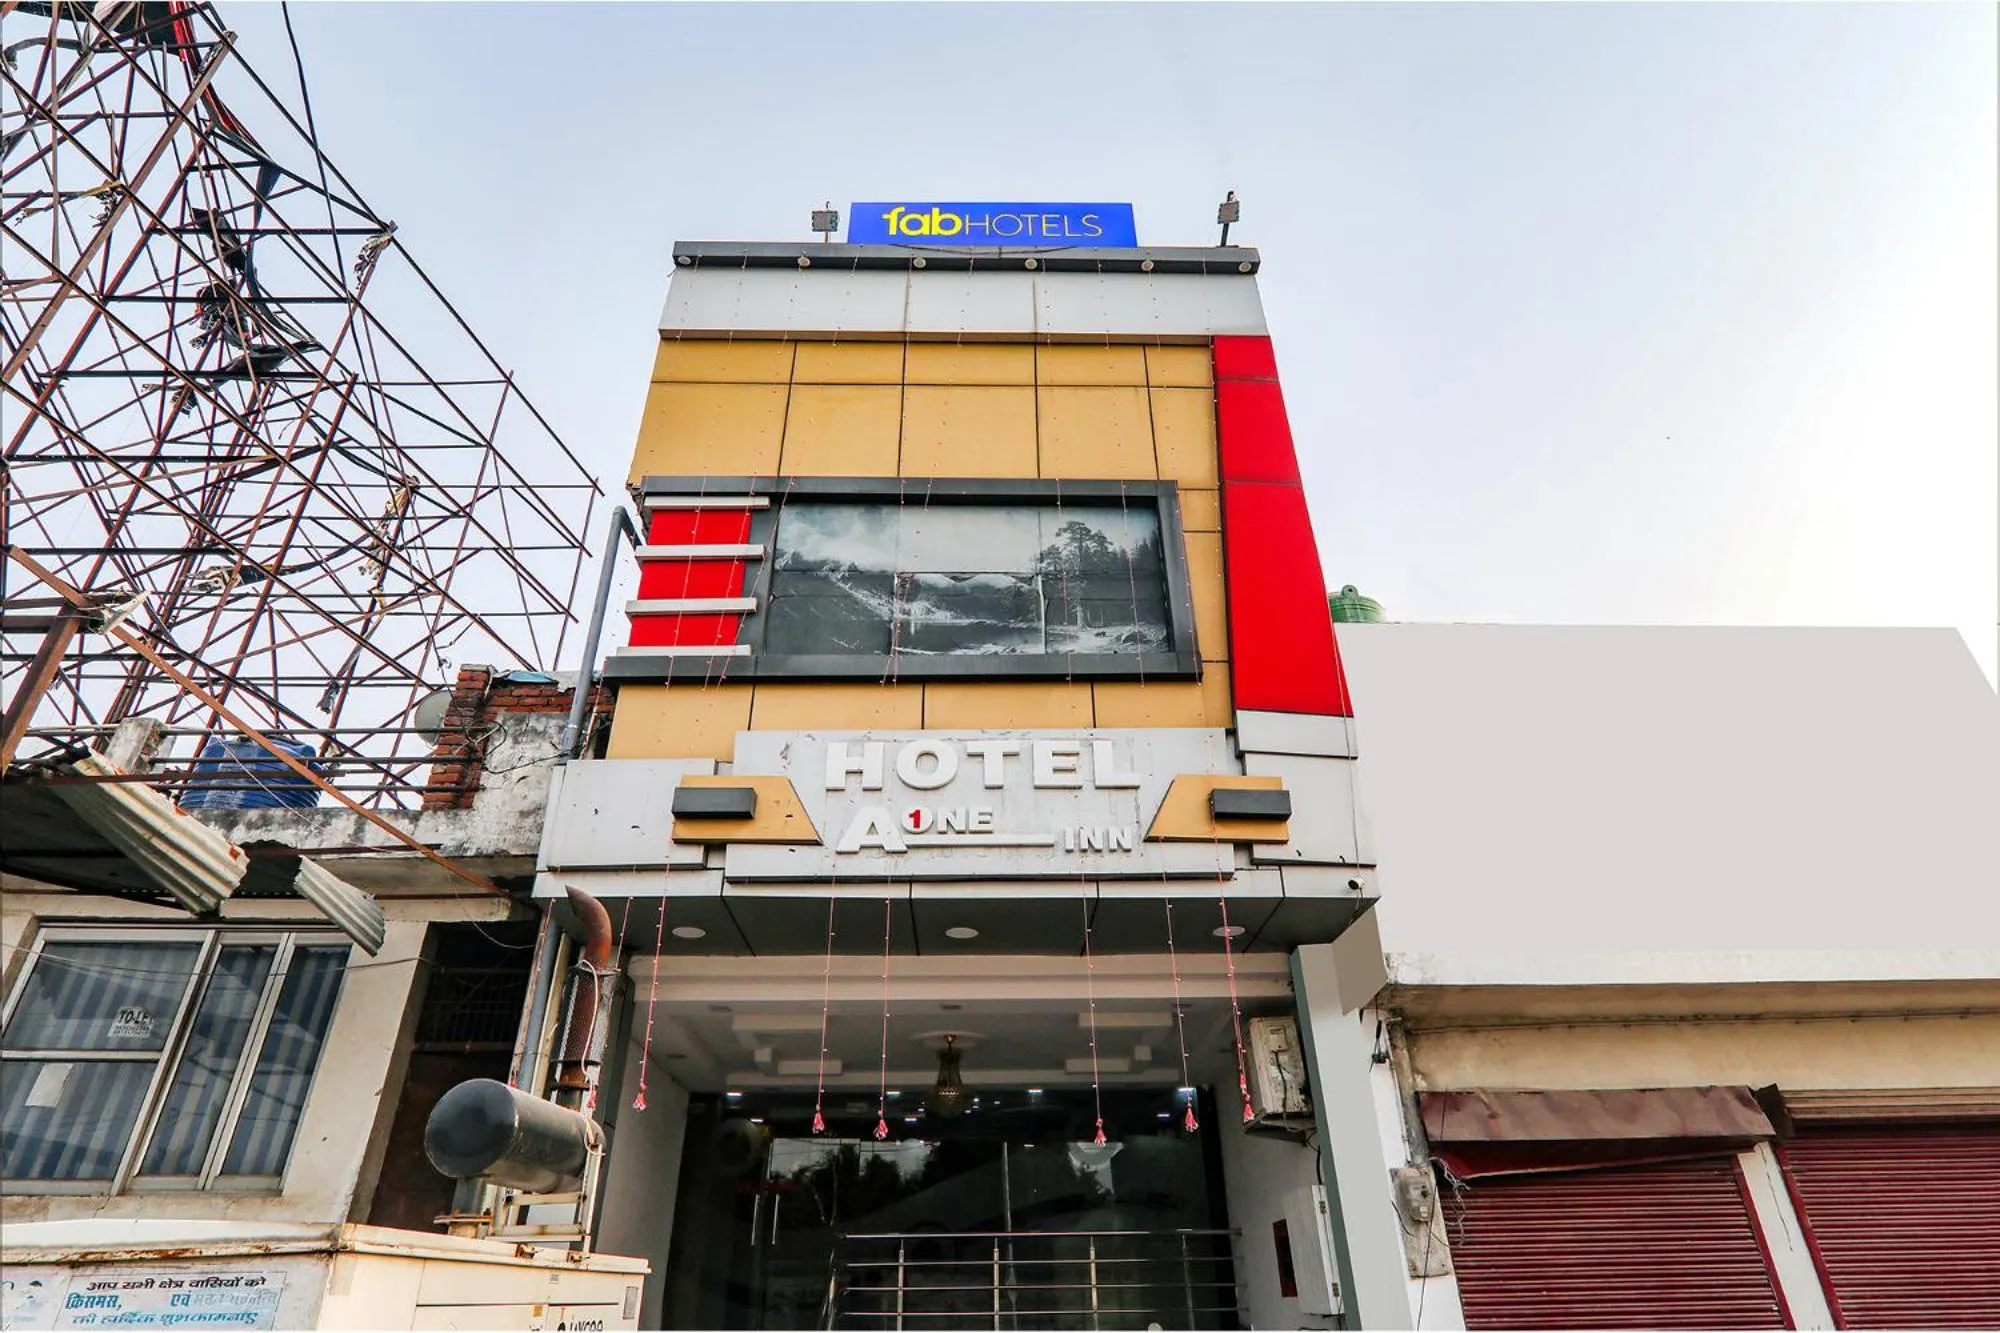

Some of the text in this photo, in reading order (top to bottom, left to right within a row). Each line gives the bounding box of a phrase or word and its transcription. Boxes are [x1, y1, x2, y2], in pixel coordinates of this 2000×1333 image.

[826, 738, 1140, 791] HOTEL
[1064, 826, 1132, 852] INN
[86, 1281, 118, 1290] आप
[122, 1278, 155, 1289] सभी
[244, 1276, 267, 1287] को
[170, 1290, 192, 1307] एवं
